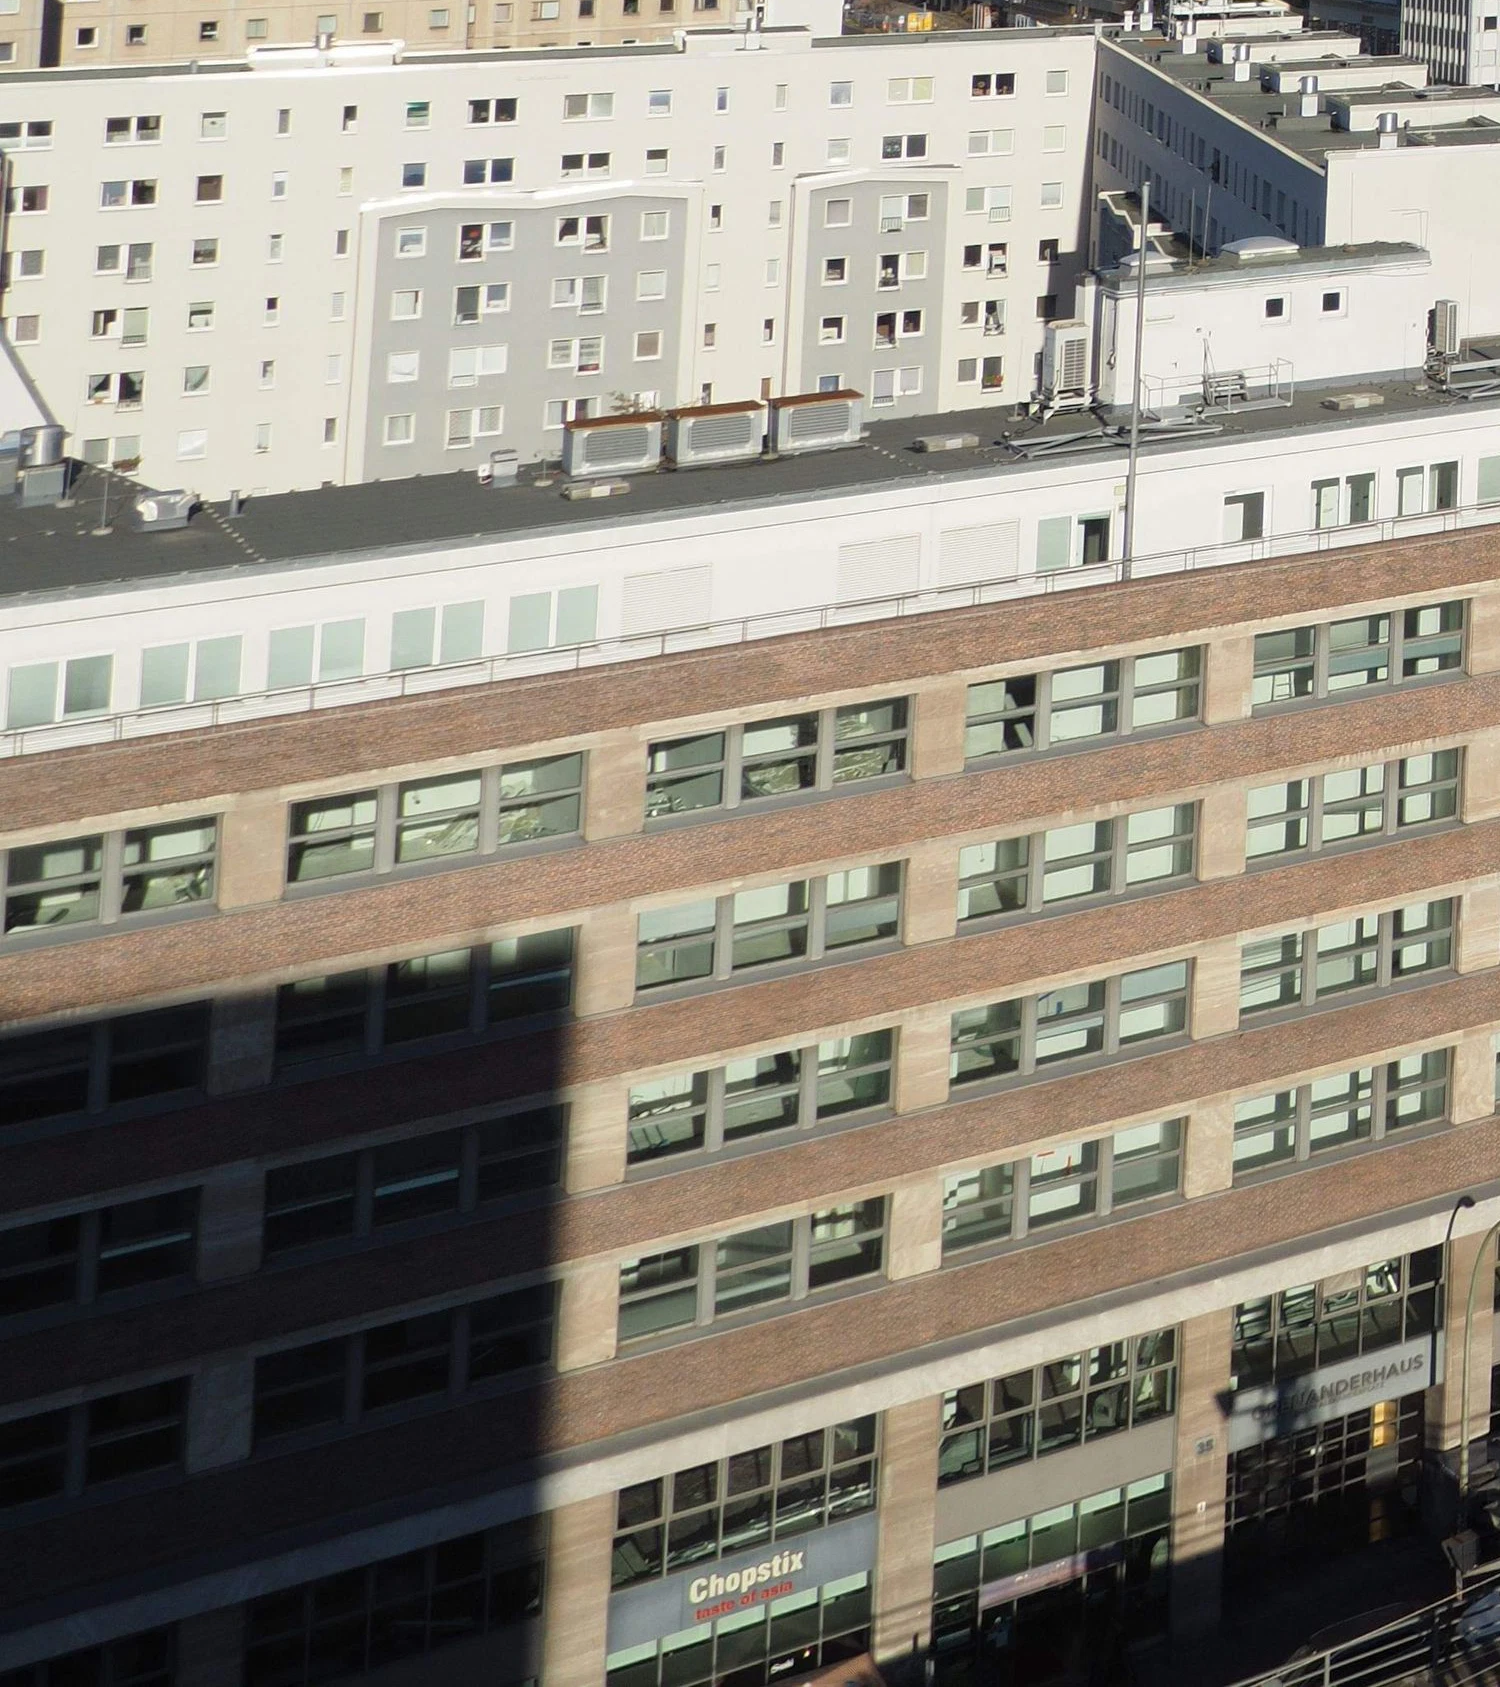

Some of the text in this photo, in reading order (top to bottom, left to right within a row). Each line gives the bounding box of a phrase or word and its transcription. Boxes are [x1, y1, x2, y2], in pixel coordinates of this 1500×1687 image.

[688, 1549, 804, 1605] Chopstix
[694, 1580, 793, 1622] taste of asia
